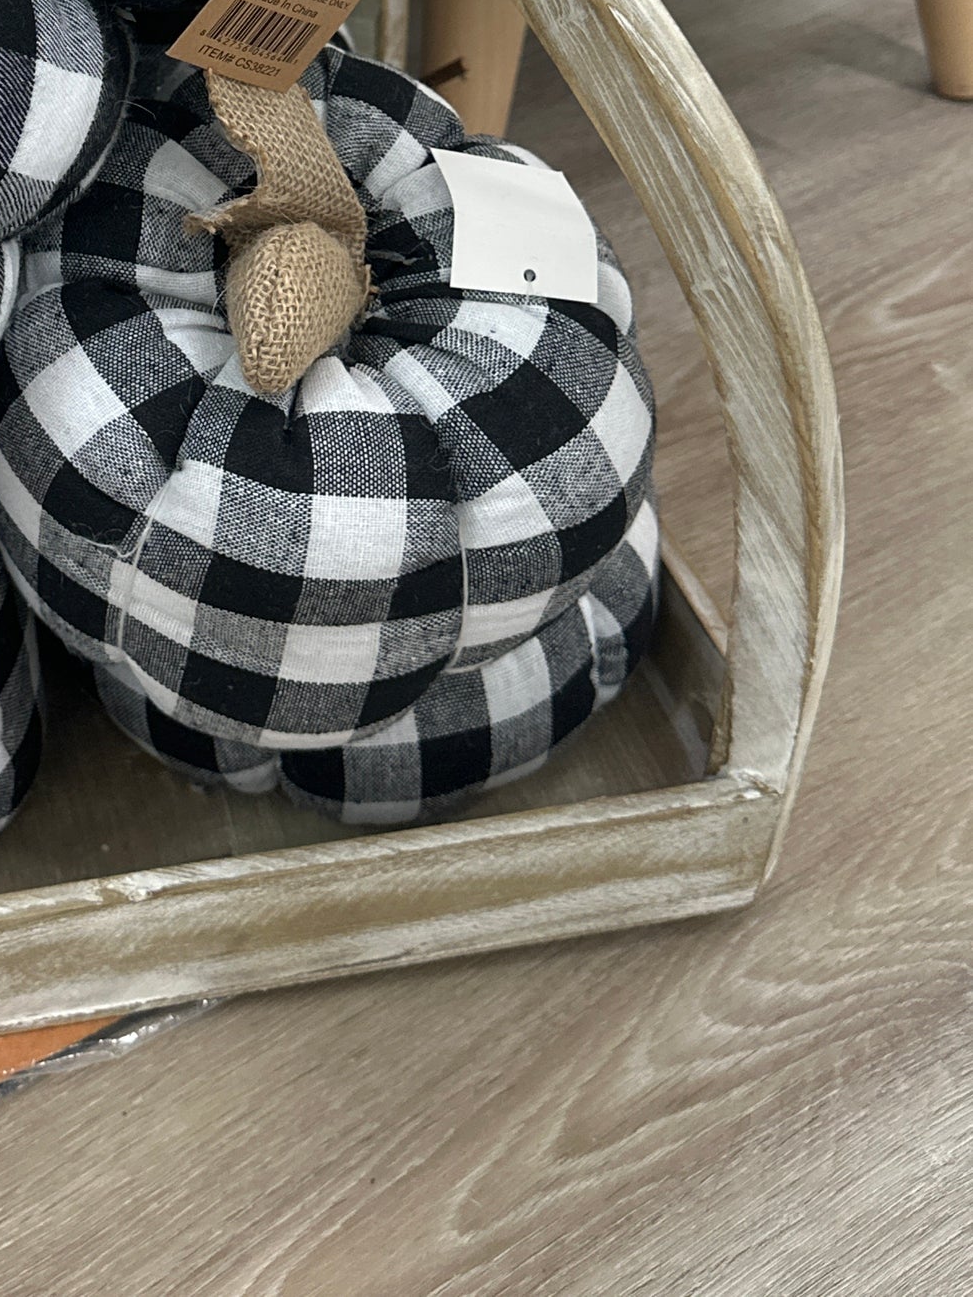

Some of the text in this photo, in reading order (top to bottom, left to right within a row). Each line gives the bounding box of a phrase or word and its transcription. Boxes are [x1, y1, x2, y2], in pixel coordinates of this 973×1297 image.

[291, 3, 319, 19] China
[197, 44, 281, 77] ITEM# CS38221
